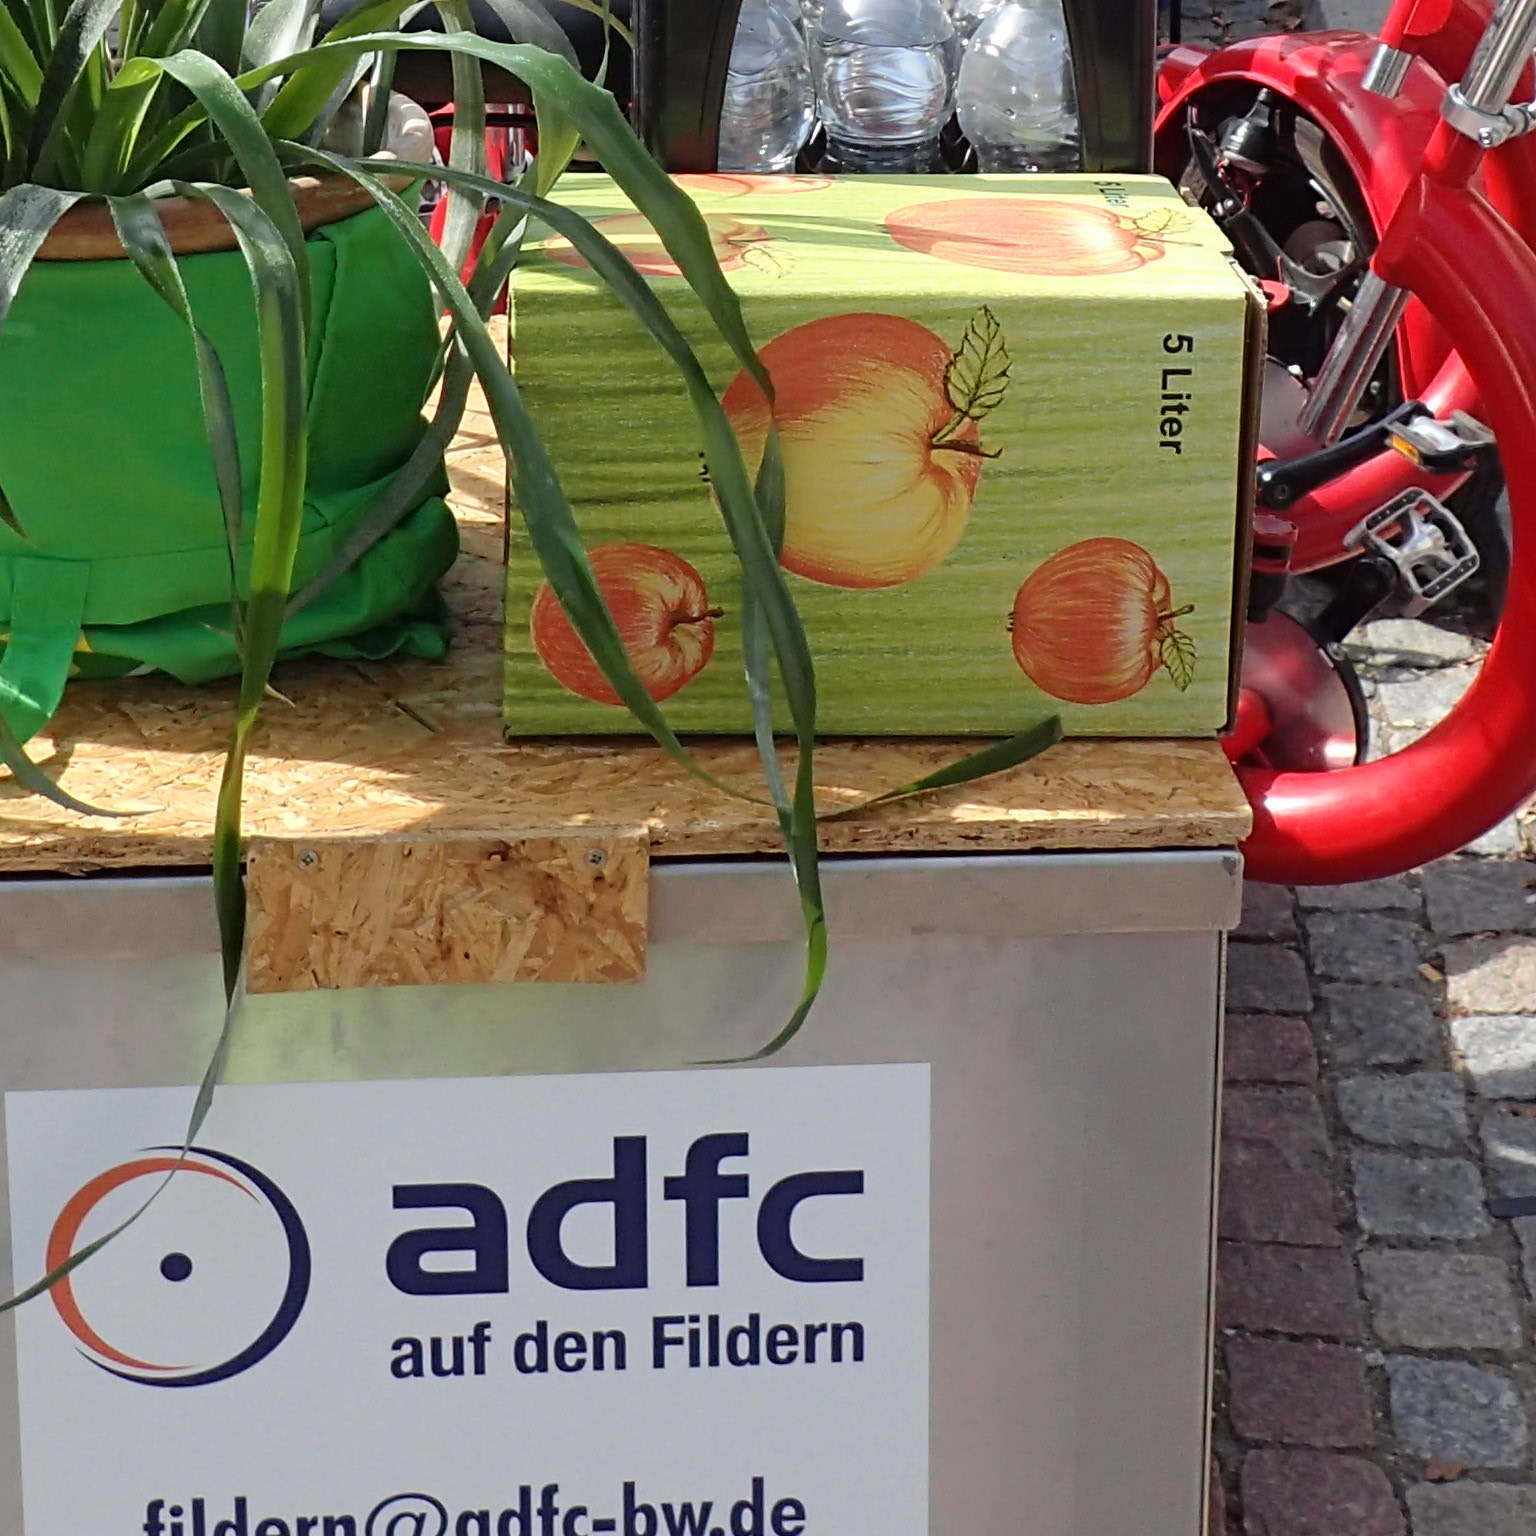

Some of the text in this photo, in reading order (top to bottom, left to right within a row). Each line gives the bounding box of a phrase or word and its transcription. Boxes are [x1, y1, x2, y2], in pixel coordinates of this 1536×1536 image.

[1159, 333, 1194, 455] 5 Liter
[386, 1132, 865, 1296] adfc
[390, 1313, 865, 1379] auf den Fildern
